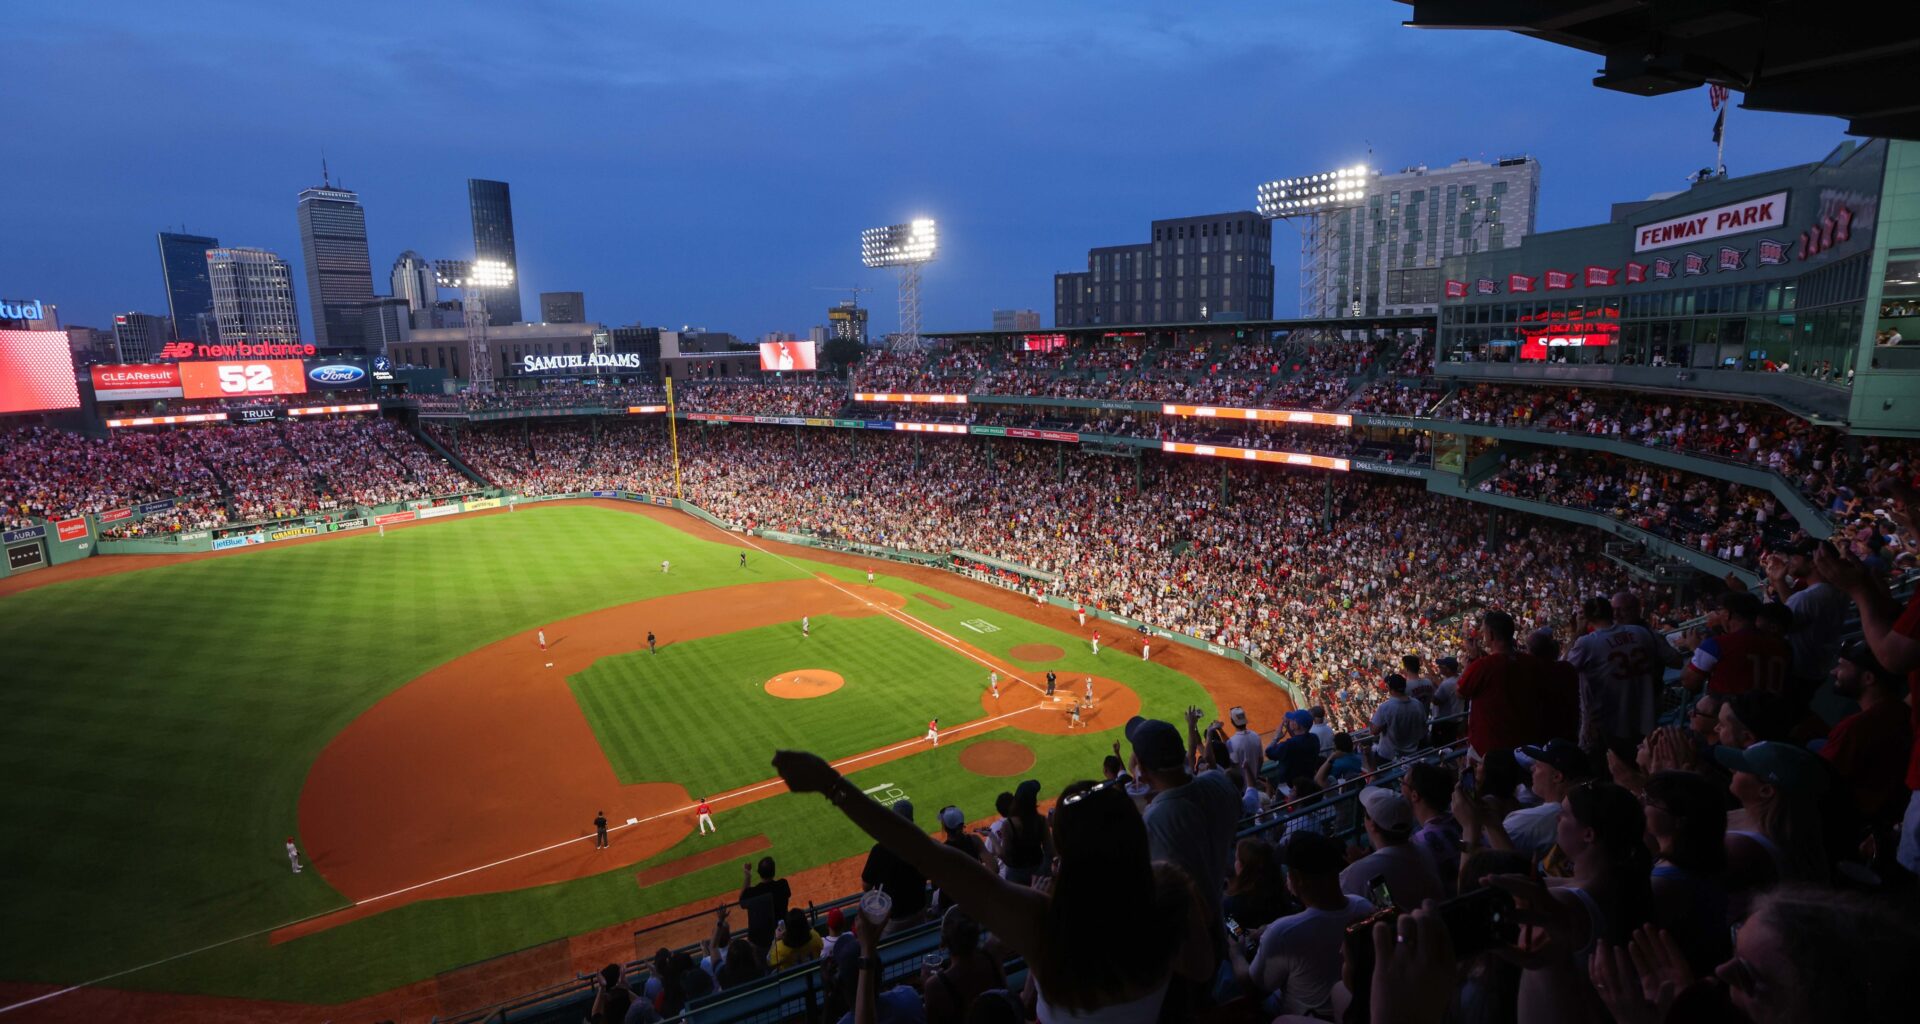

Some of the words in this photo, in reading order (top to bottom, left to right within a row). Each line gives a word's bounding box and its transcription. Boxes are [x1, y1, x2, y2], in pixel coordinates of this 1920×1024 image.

[1641, 217, 1708, 246] FENWAY
[1717, 202, 1773, 230] PARK
[198, 344, 237, 357] new
[238, 340, 316, 356] balance
[524, 355, 586, 372] SAMUEL
[587, 353, 640, 368] ADAMS
[101, 371, 173, 381] CLEAResult
[218, 364, 273, 393] 52
[320, 367, 353, 381] Ford
[242, 409, 274, 418] TRULY
[339, 520, 363, 528] wasabi
[272, 529, 300, 540] GRANITE
[302, 527, 316, 535] CITY
[216, 539, 242, 549] jetBlue
[1609, 649, 1648, 679] 32
[1747, 653, 1785, 693] 10
